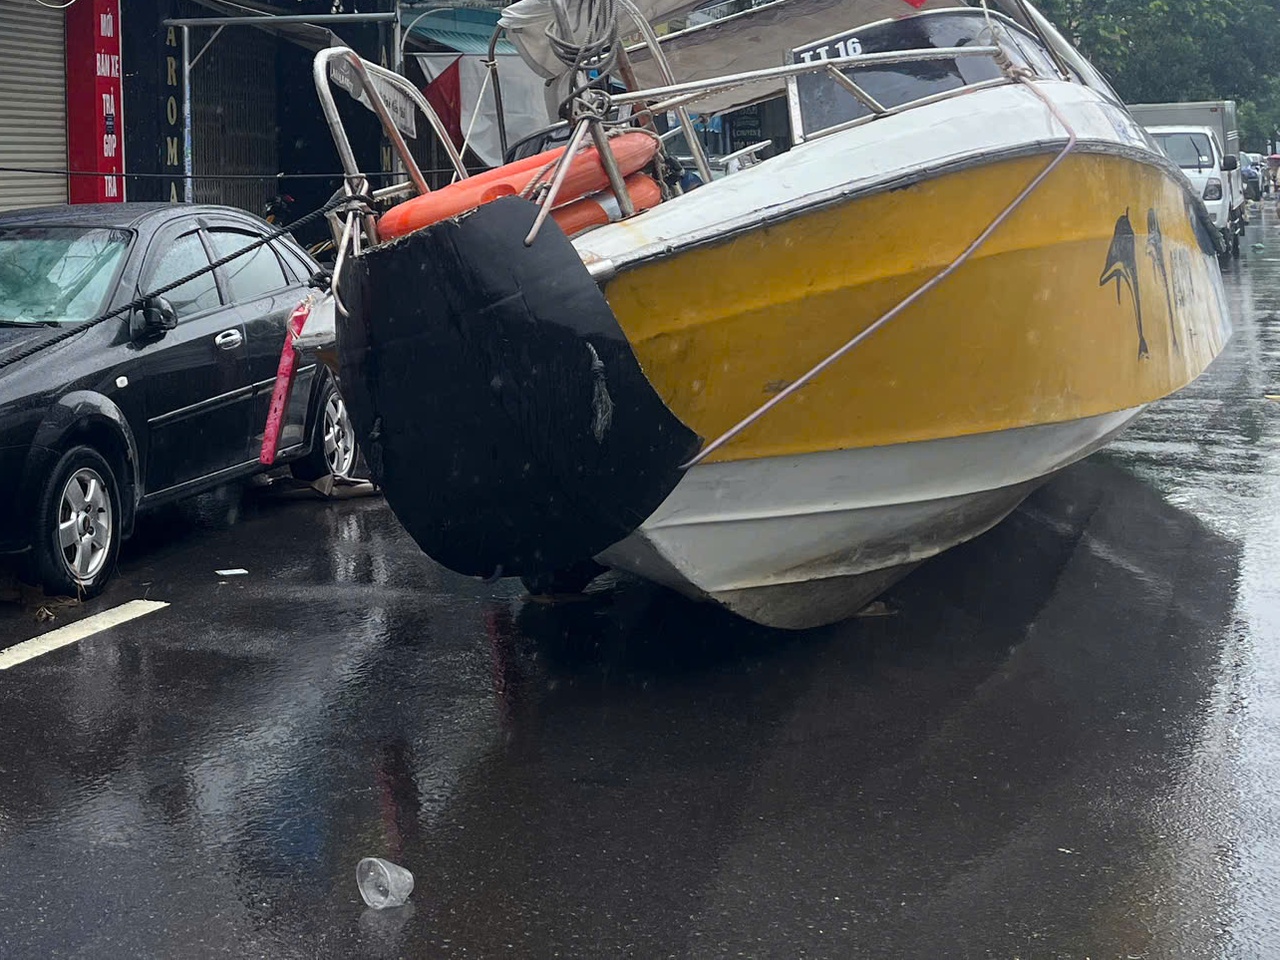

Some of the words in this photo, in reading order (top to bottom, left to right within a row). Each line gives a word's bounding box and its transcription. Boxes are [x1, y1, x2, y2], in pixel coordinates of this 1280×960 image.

[834, 38, 863, 58] 16
[110, 54, 120, 77] XE
[165, 26, 178, 204] AROMA
